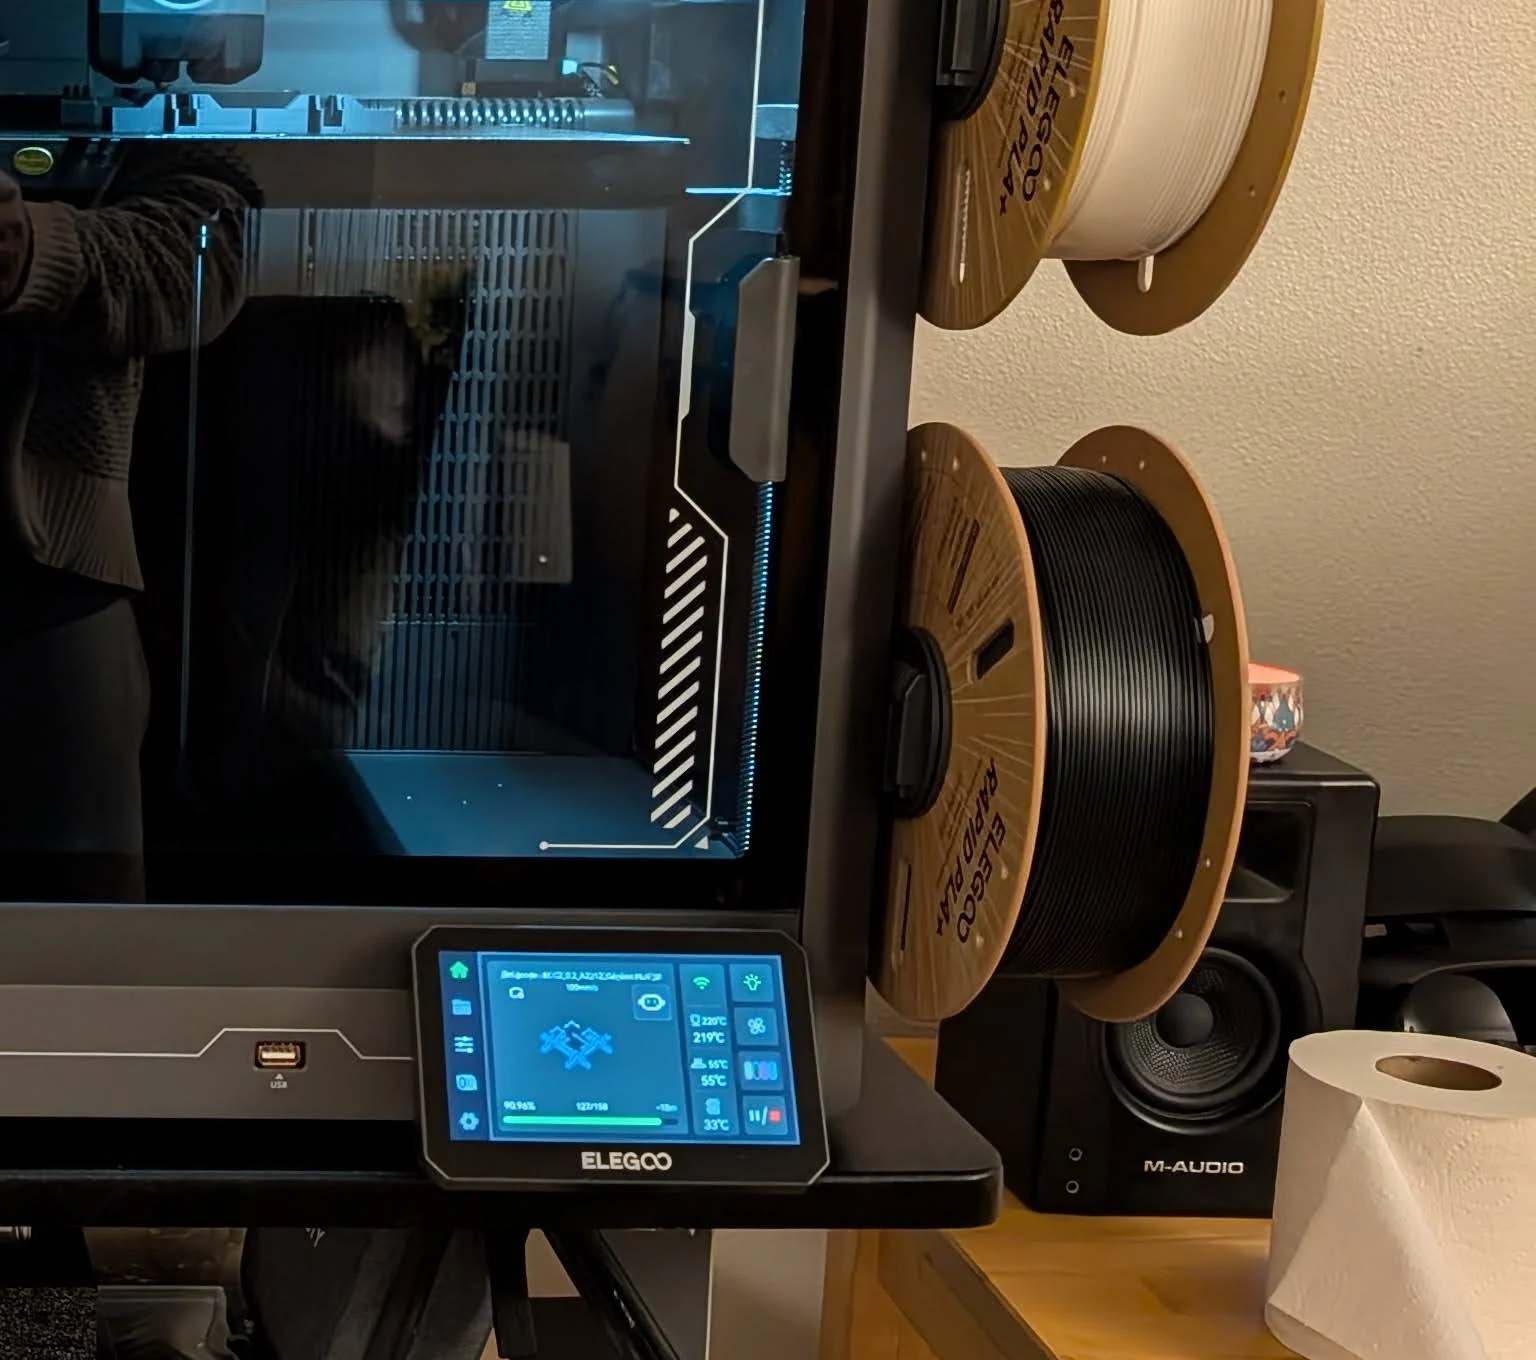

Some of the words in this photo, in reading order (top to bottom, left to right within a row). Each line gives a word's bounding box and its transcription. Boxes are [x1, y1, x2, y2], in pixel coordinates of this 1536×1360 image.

[1022, 35, 1074, 202] ELEGOO
[962, 757, 998, 865] RAPID
[956, 811, 1006, 944] ELEGOO
[269, 1080, 288, 1089] USB
[581, 1151, 673, 1171] ELEGOO
[1143, 1160, 1245, 1174] M-AUDIO
